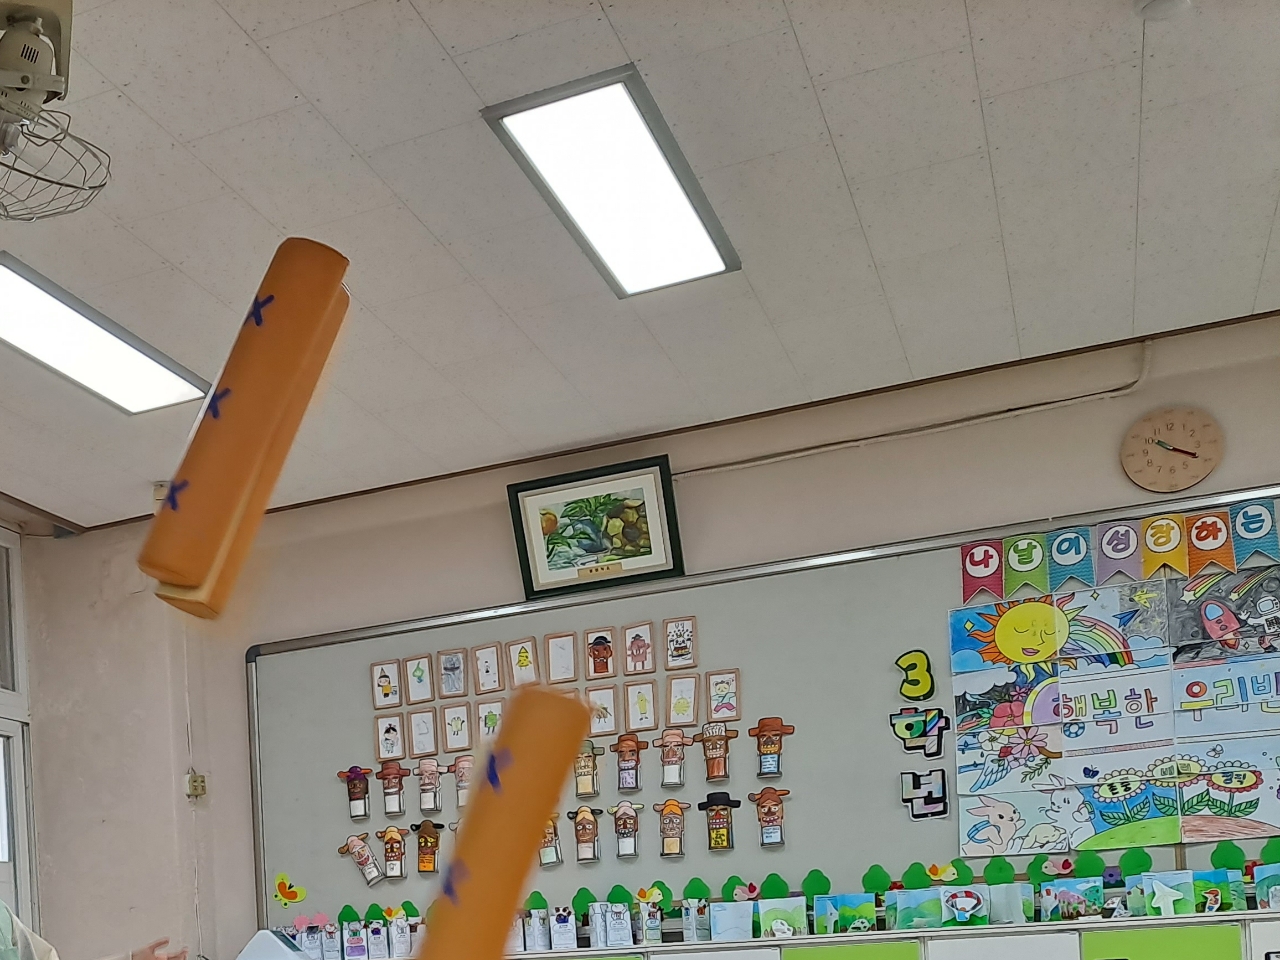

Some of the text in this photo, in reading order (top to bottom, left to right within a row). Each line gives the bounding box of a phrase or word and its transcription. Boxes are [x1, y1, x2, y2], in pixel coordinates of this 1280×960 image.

[1166, 422, 1175, 431] 12
[1153, 428, 1161, 436] 11
[1189, 429, 1196, 438] 2
[1144, 436, 1154, 445] 10
[1194, 440, 1201, 449] 3
[1142, 448, 1149, 457] 9
[1146, 459, 1153, 467] 8
[1182, 461, 1189, 470] 5
[1169, 465, 1176, 474] 6
[969, 508, 1265, 569] 나날이 성장하는
[1051, 687, 1159, 739] 행복한
[888, 649, 951, 820] 3학년
